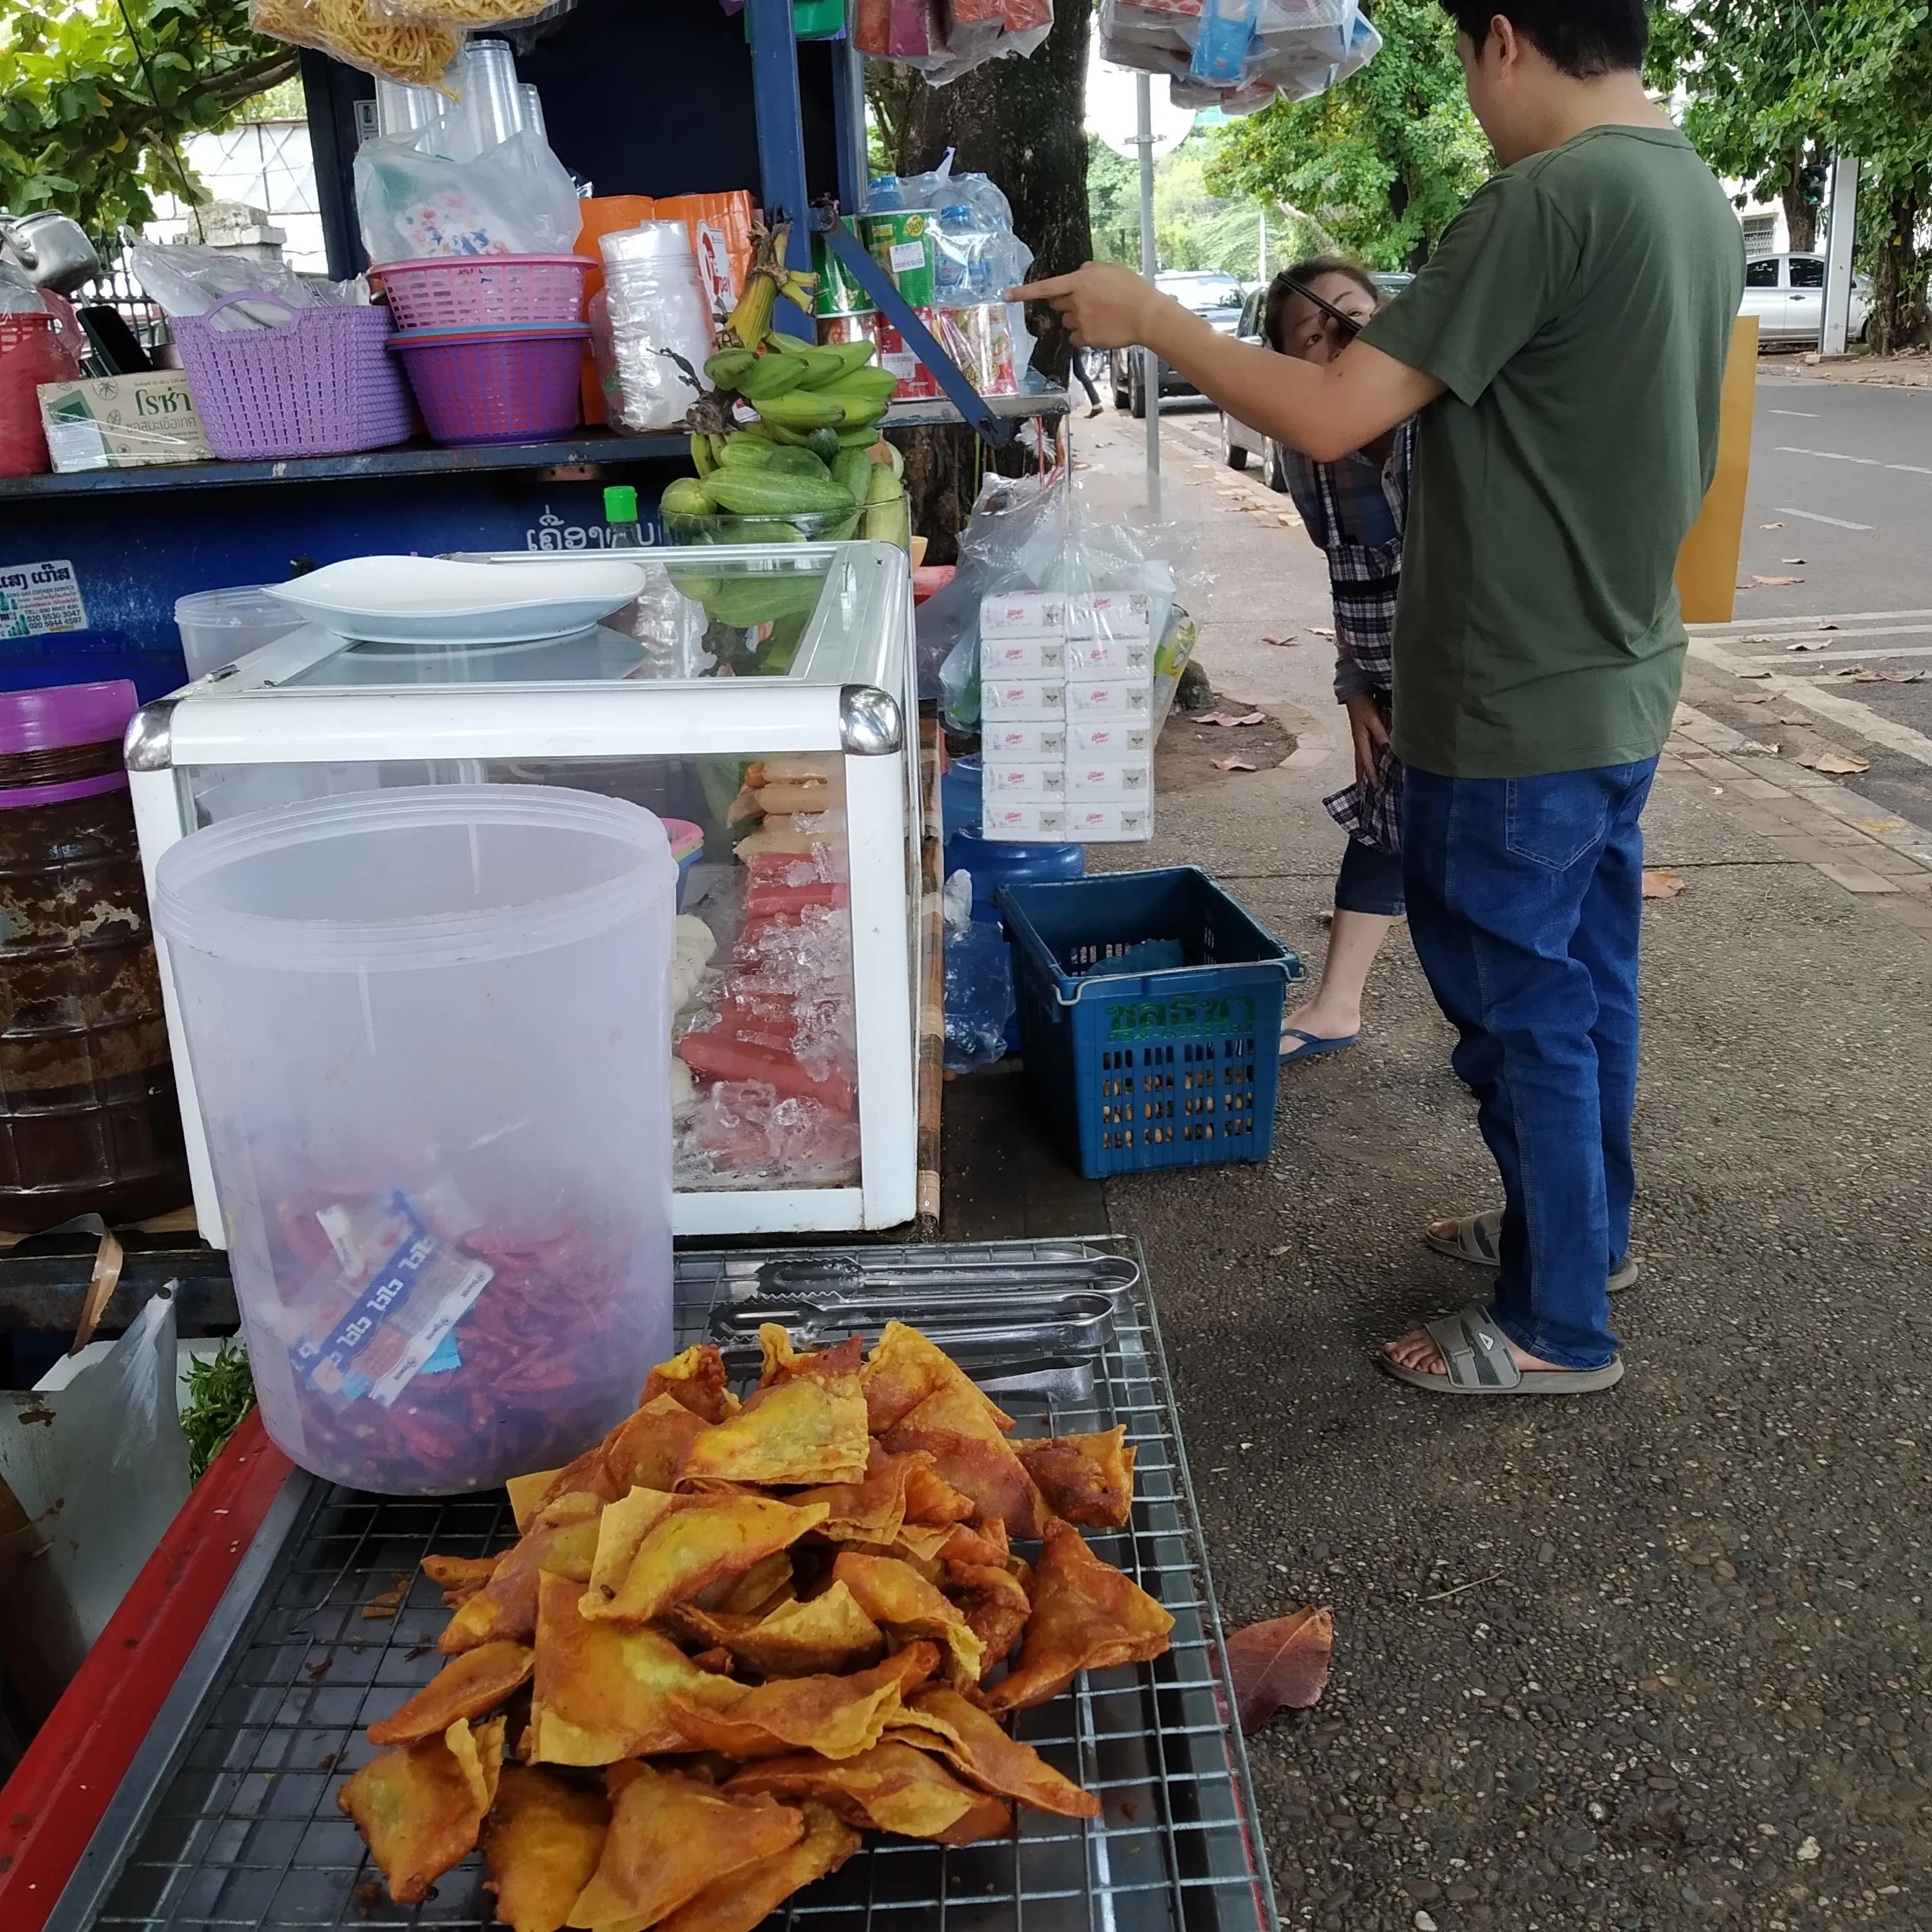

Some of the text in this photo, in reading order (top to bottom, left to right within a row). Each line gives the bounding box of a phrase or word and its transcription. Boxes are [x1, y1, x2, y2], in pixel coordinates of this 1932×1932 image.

[27, 614, 41, 623] 020
[43, 612, 61, 621] 5530
[62, 609, 80, 618] 3047
